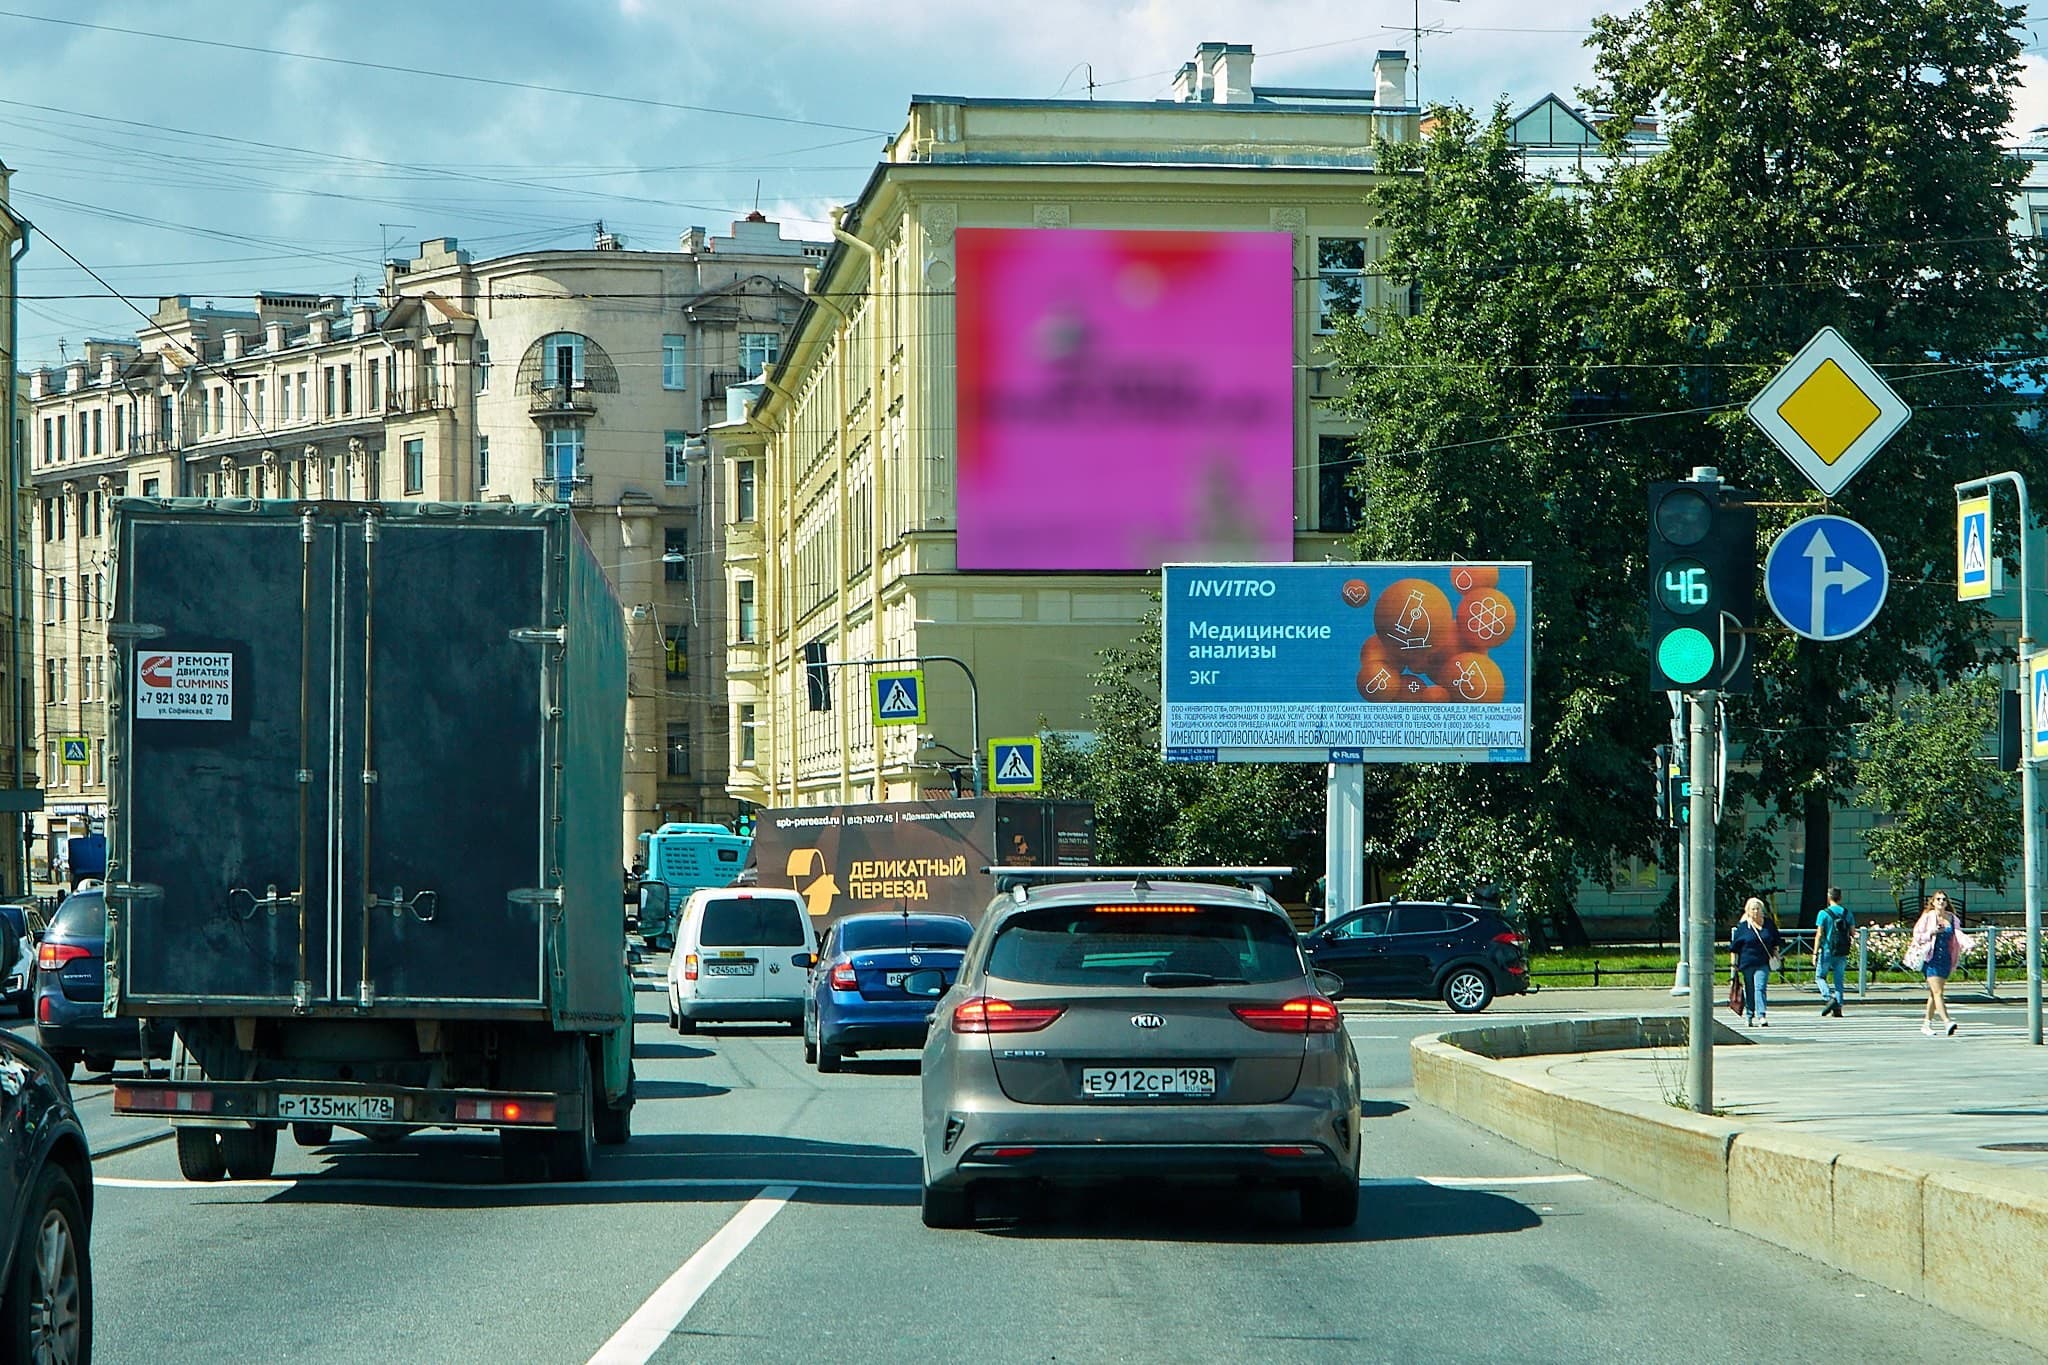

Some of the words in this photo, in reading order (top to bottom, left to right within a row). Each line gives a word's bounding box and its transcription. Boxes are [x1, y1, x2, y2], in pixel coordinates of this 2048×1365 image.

[1188, 580, 1276, 597] INVITRO
[1665, 568, 1708, 605] 46
[1189, 621, 1331, 641] Медицинские
[1189, 645, 1276, 659] анализы
[177, 656, 229, 666] РЕМОНТ
[176, 668, 229, 677] ДВИГАТЕЛЯ
[1189, 670, 1220, 685] ЭКГ
[176, 679, 229, 689] CUMMINS
[140, 692, 153, 704] +7
[155, 692, 174, 704] 921
[178, 693, 197, 705] 934
[200, 693, 213, 705] 02
[216, 693, 229, 705] 70
[1170, 730, 1209, 745] ИМЕЮТСЯ
[1210, 730, 1297, 745] ПРОТИВОПОКАЗАНИЯ.
[1298, 730, 1354, 747] НЕОБХОДИМО
[1355, 730, 1402, 745] ПОЛУЧЕНИЕ
[1404, 730, 1465, 747] КОНСУЛЬТАЦИИ
[1466, 730, 1525, 746] СПЕЦИАЛИСТА.
[776, 815, 840, 829] spb-pereezd.ru
[863, 815, 874, 825] 740
[874, 815, 884, 824] 77
[884, 815, 894, 824] 45
[849, 855, 967, 882] ДЕЛИКАТНЫЙ
[850, 880, 929, 900] ПЕРЕЕЗД
[1137, 1014, 1162, 1028] KIA
[1090, 1070, 1174, 1091] Е912СР
[1179, 1069, 1210, 1085] 198
[362, 1098, 389, 1113] 178
